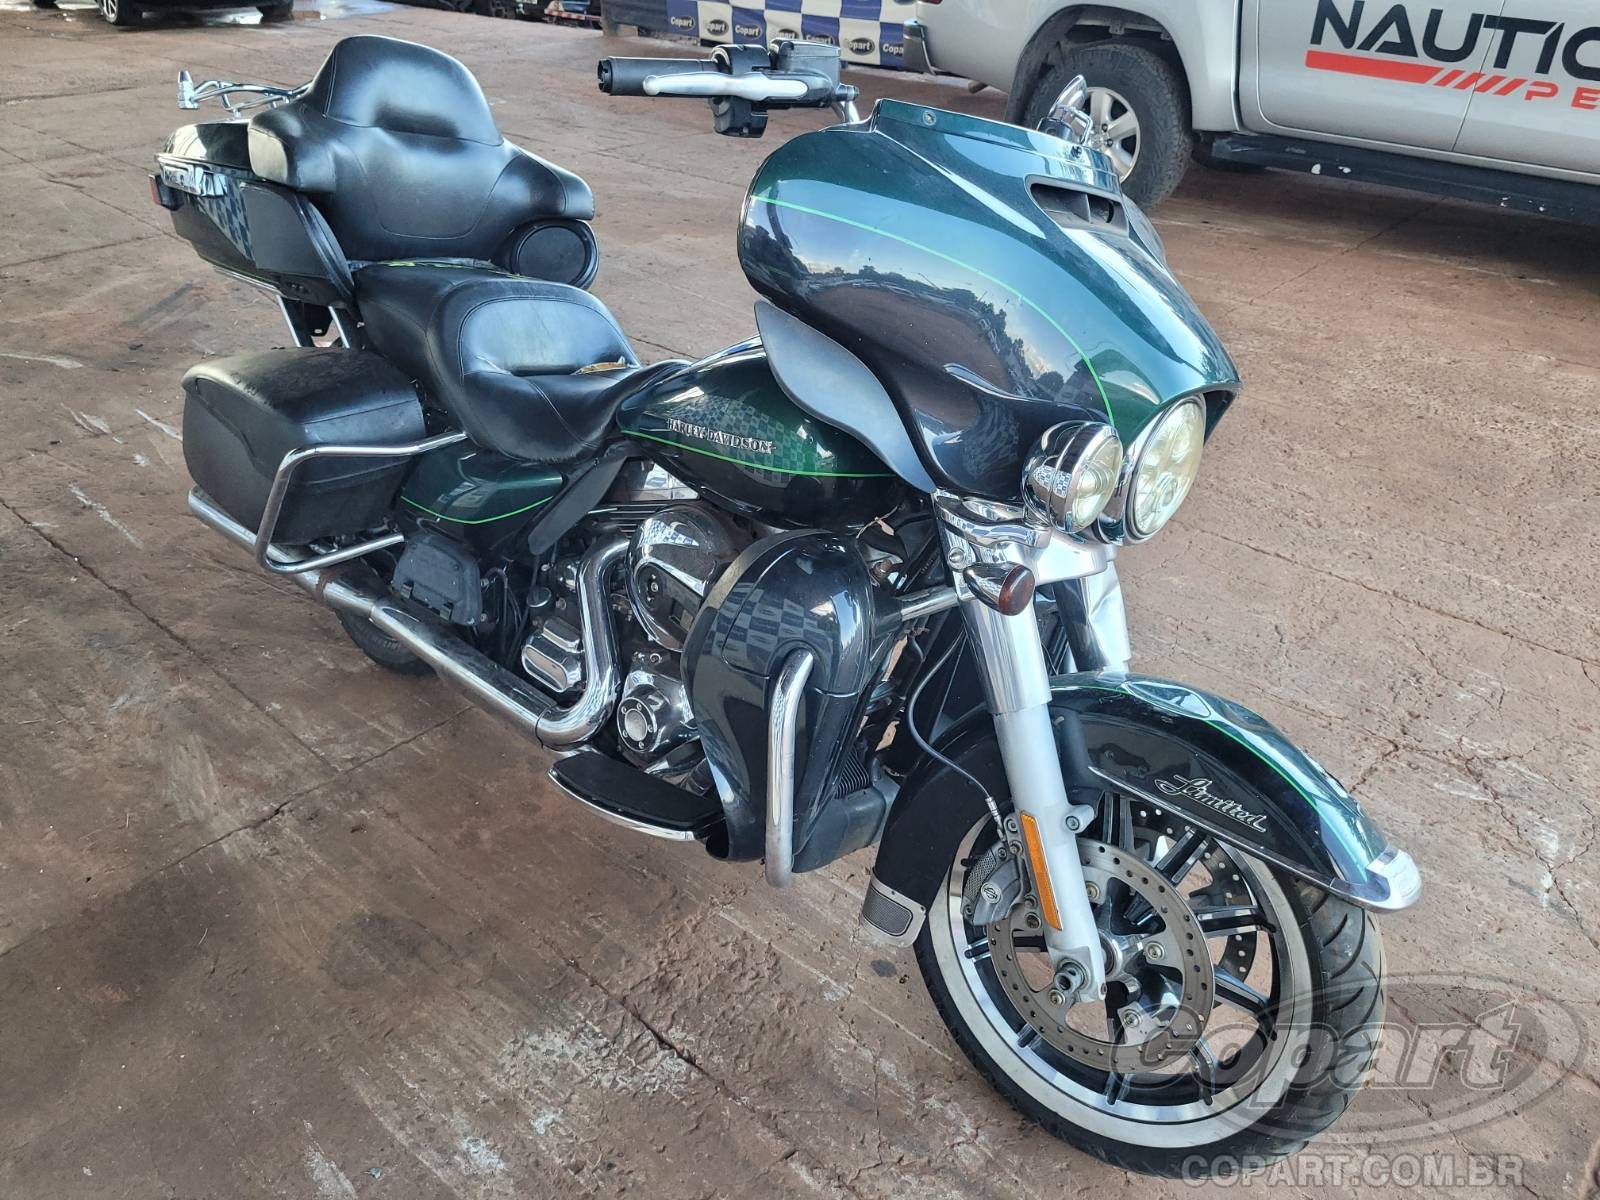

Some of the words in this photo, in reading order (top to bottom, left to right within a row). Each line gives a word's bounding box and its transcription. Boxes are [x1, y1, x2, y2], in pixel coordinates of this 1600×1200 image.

[670, 16, 693, 27] Copart
[735, 25, 760, 36] Copart
[1154, 774, 1267, 833] Limited
